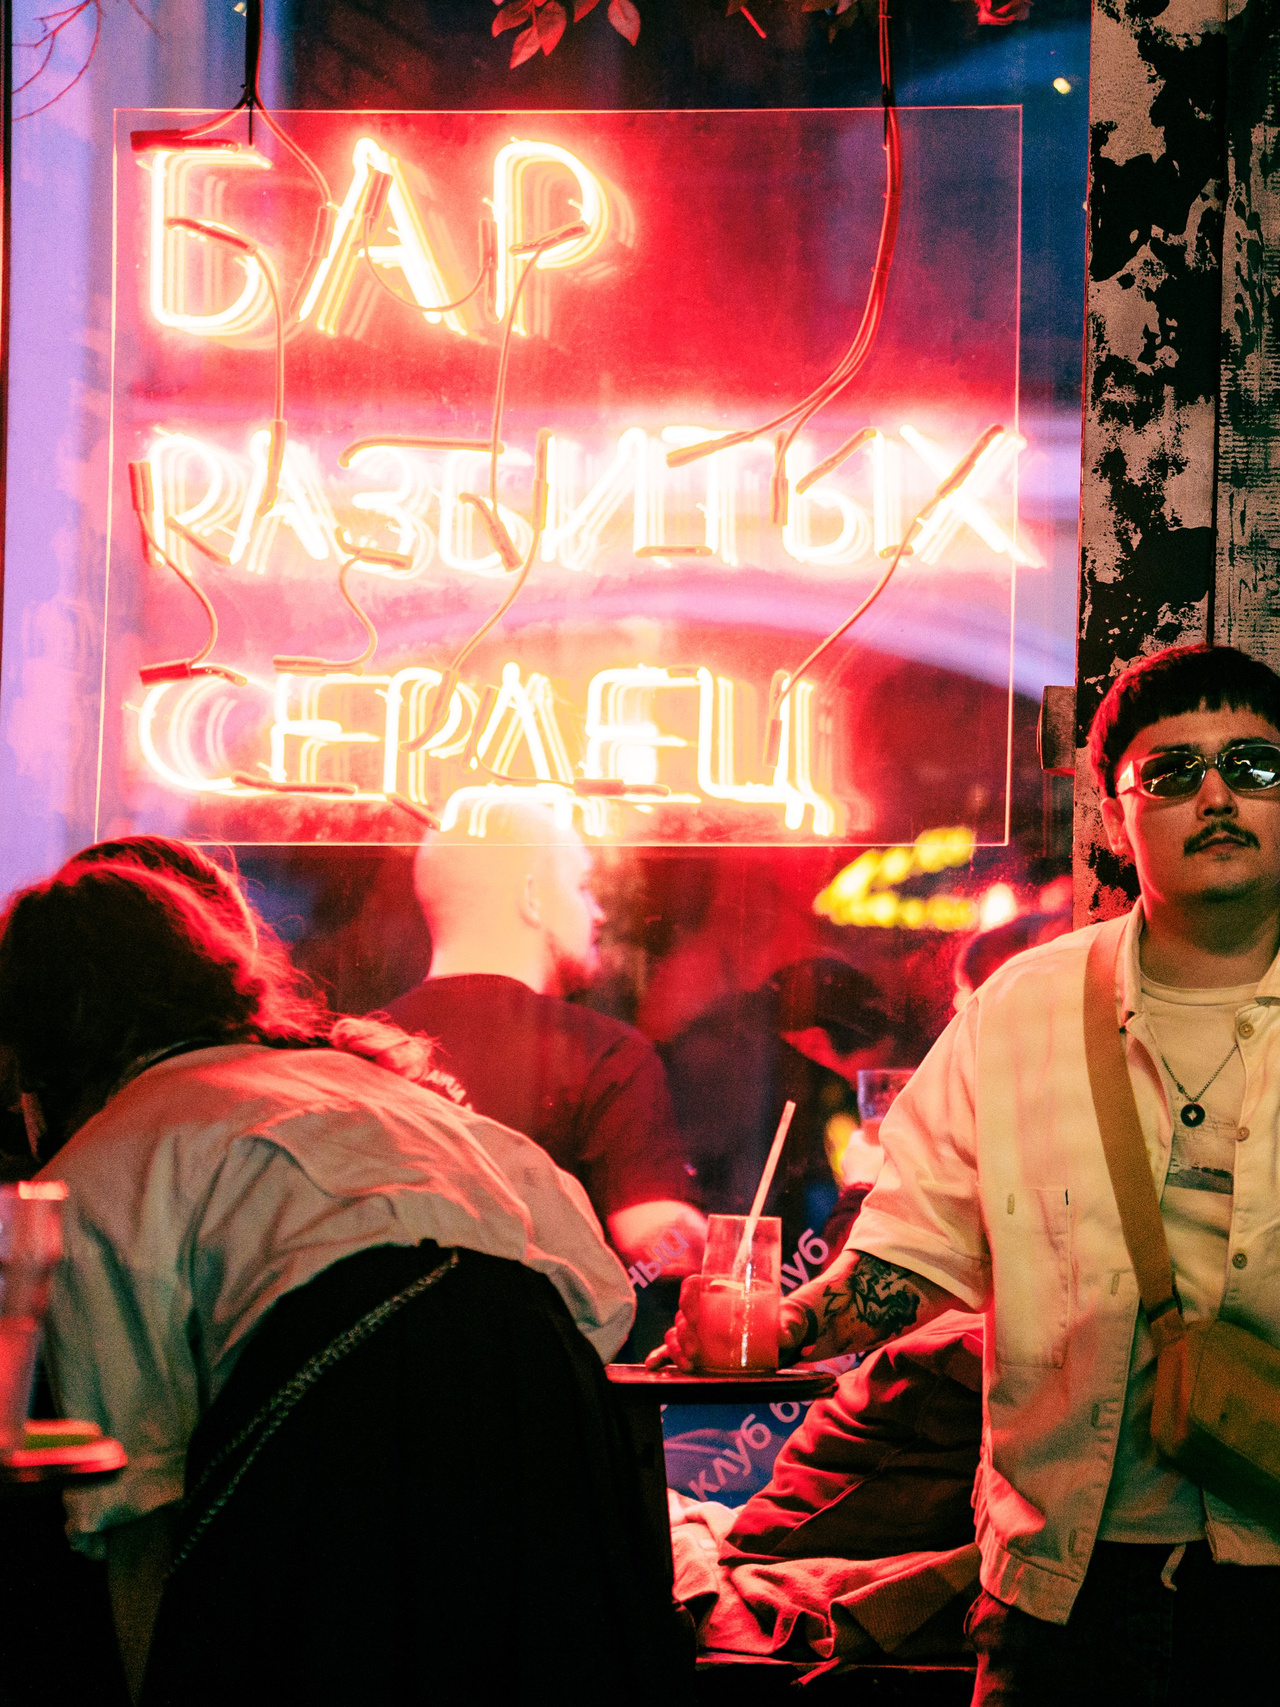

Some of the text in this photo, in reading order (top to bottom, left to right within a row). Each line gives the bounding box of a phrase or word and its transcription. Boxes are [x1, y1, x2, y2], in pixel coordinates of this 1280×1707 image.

[138, 136, 606, 334] БАР
[138, 422, 1036, 570] РАЗБИТЫХ
[130, 663, 832, 834] СЕРДЕЦ
[688, 1413, 772, 1502] клуб
